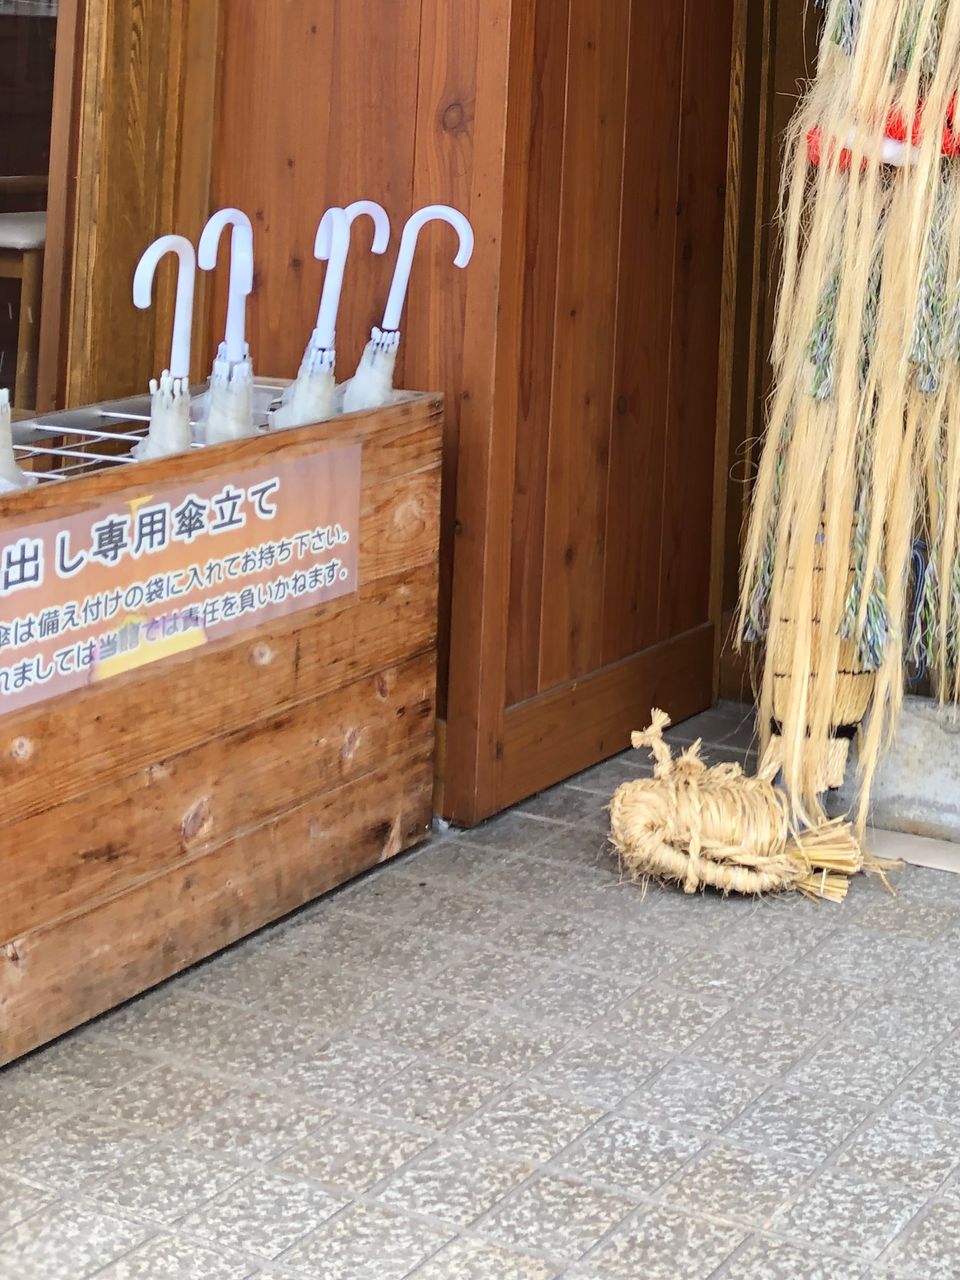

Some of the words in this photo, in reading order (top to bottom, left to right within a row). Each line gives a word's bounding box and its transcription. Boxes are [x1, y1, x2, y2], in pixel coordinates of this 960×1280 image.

[3, 481, 278, 590] 出し専用傘立て
[0, 562, 346, 691] ましては当では責任を負いかねます。
